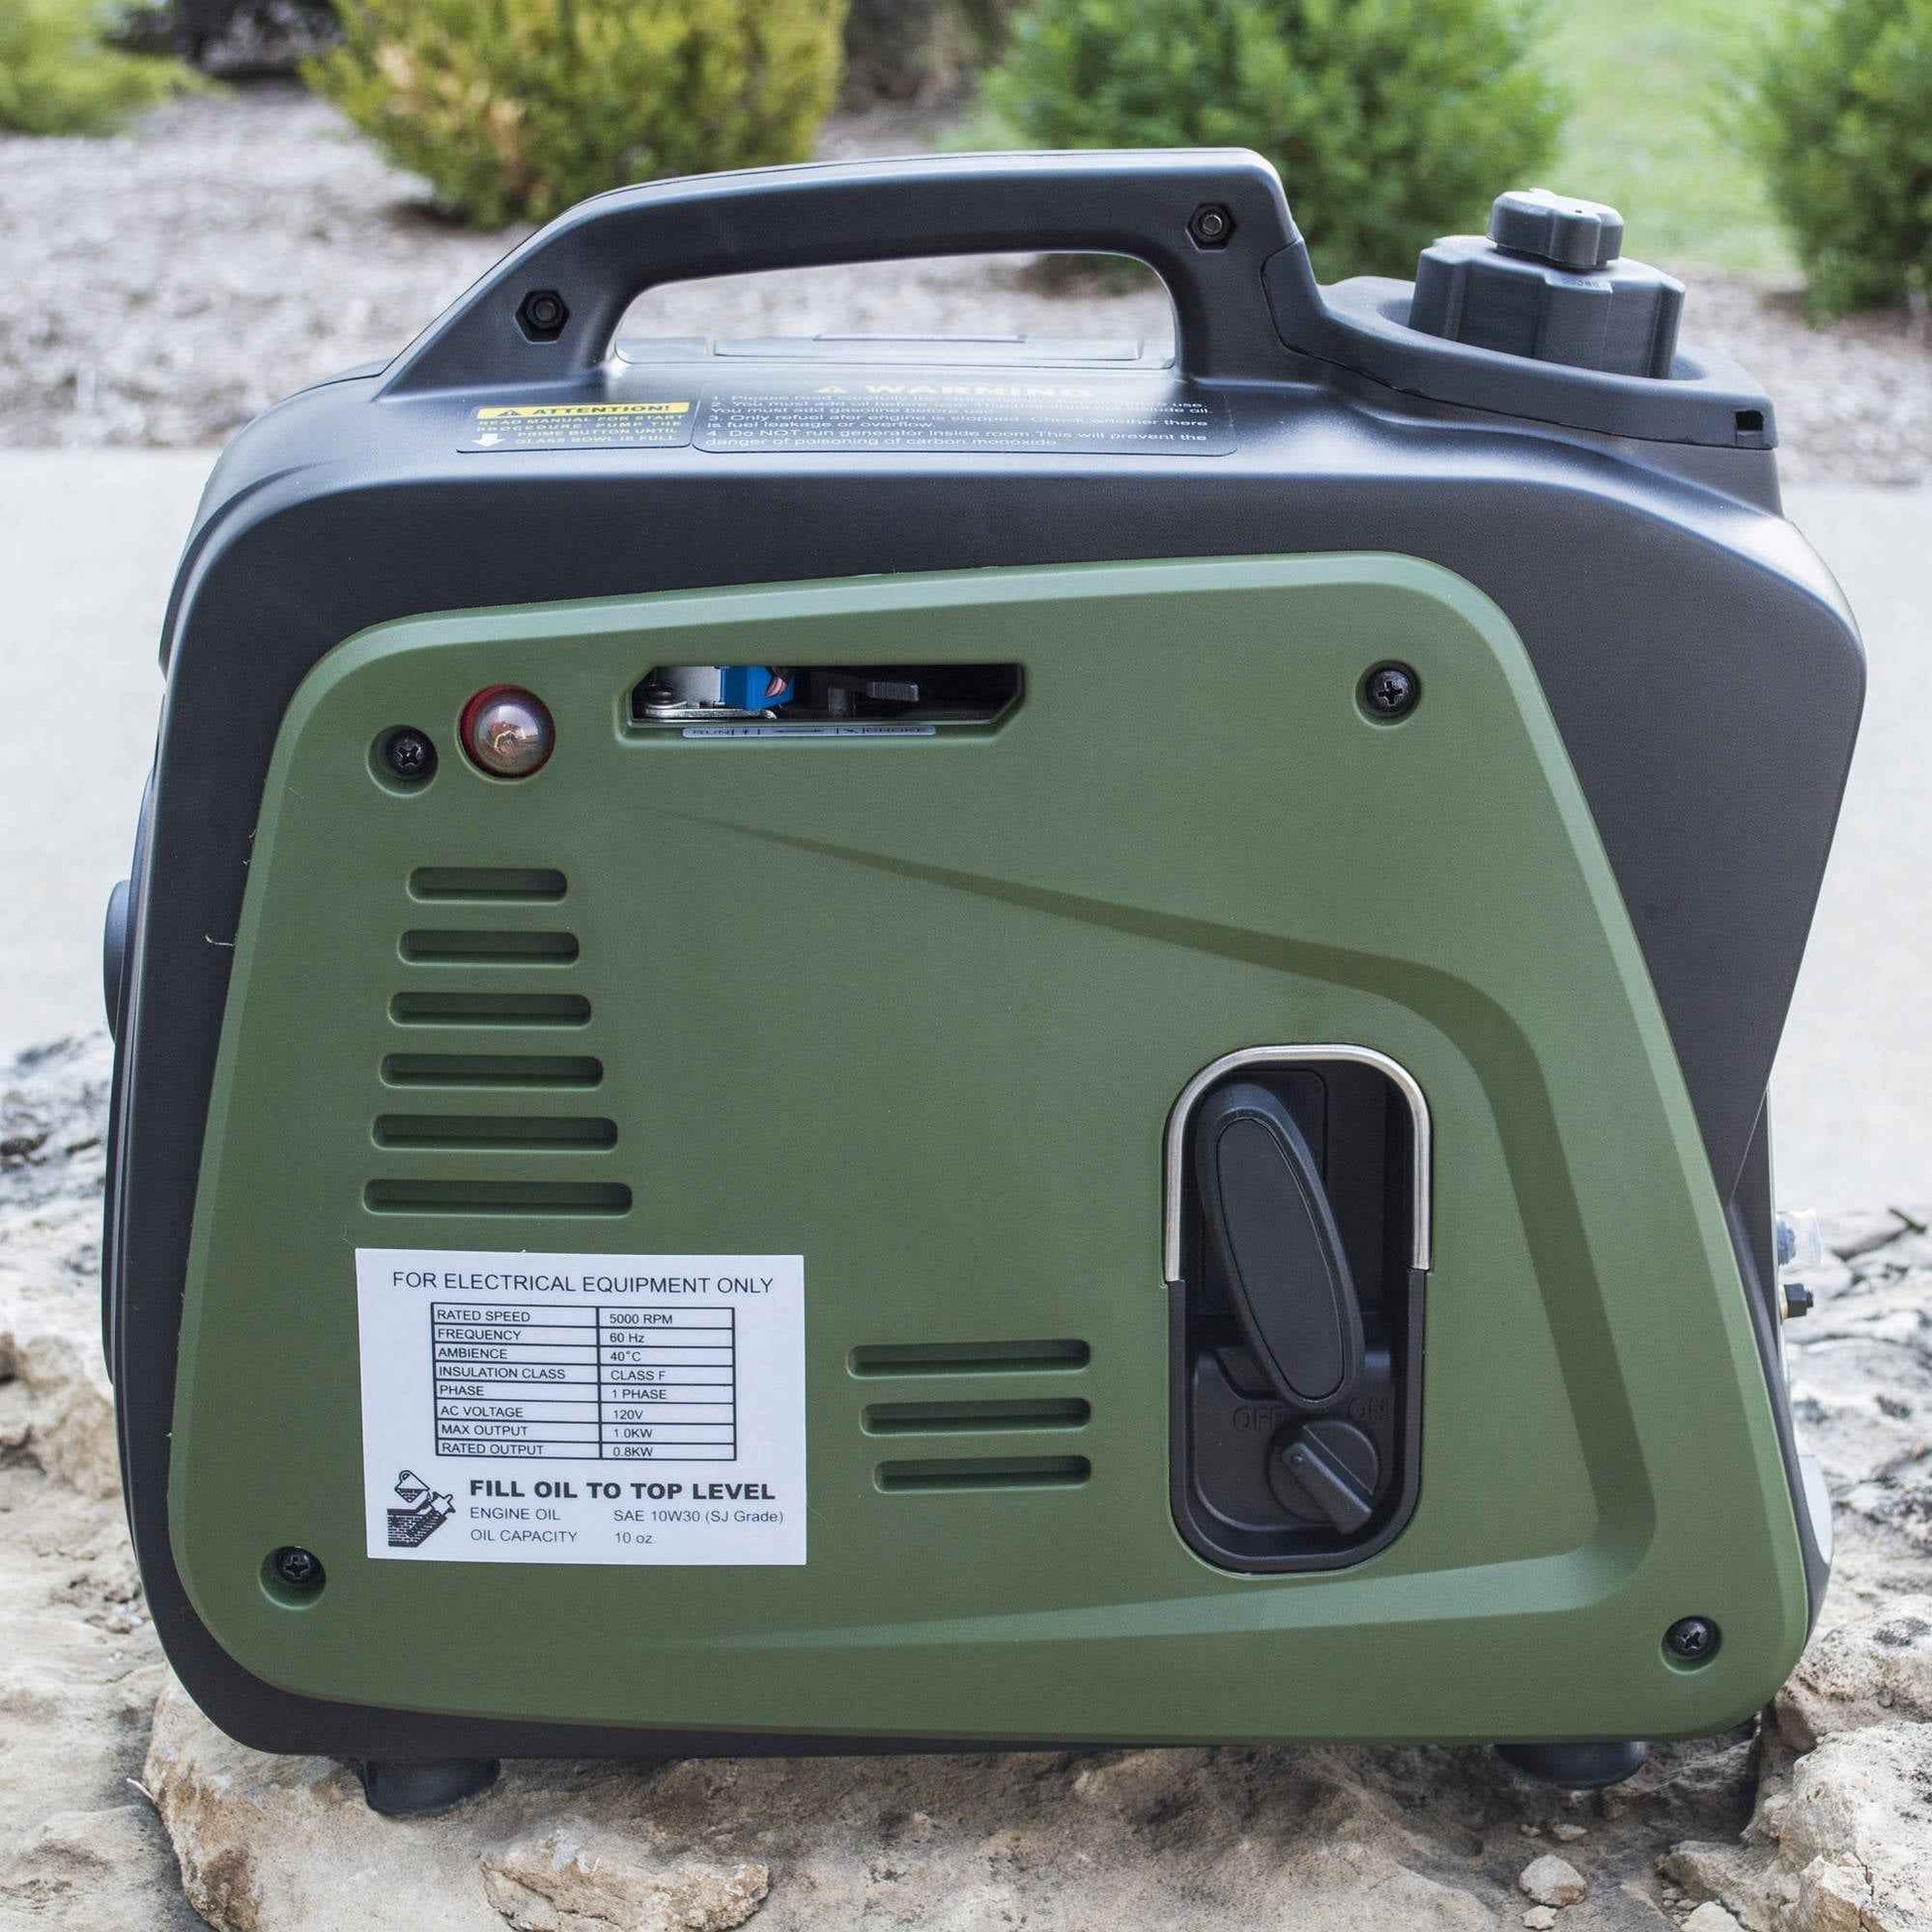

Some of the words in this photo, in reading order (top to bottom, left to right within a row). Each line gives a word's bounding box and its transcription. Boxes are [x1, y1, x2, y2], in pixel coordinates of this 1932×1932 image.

[866, 385, 1093, 397] WARNING
[533, 405, 670, 415] ATTENTION!
[526, 416, 594, 425] MANUAL
[840, 429, 923, 438] generator
[1078, 431, 1105, 440] will
[1110, 432, 1176, 441] prevent
[706, 438, 768, 447] danger
[795, 437, 880, 447] poisoning
[906, 437, 967, 446] carbon
[393, 1272, 437, 1288] FOR
[445, 1274, 576, 1292] ELECTRICAL
[583, 1277, 710, 1293] EQUIPMENT
[718, 1278, 772, 1294] ONLY
[437, 1310, 481, 1322] RATED
[485, 1311, 530, 1321] SPEED
[610, 1313, 639, 1324] 5000
[643, 1314, 672, 1323] RPM
[437, 1328, 521, 1342] FREQUENCY
[610, 1332, 624, 1342] 60
[628, 1333, 644, 1343] Hz
[438, 1347, 507, 1360] AMBIENCE
[439, 1366, 517, 1379] INSULATION
[522, 1368, 565, 1379] CLASS
[611, 1370, 654, 1381] CLASS
[659, 1371, 665, 1380] F
[440, 1385, 483, 1396] PHASE
[613, 1389, 617, 1398] 1
[622, 1389, 666, 1399] PHASE
[441, 1406, 459, 1416] AC
[463, 1407, 522, 1419] VOLTAGE
[615, 1410, 643, 1420] 120V
[442, 1425, 470, 1435] MAX
[475, 1425, 527, 1436] OUTPUT
[614, 1429, 652, 1438] 1.0KW
[442, 1443, 485, 1454] RATED
[488, 1445, 543, 1456] OUTPUT
[614, 1447, 652, 1458] 0.8KW
[471, 1480, 524, 1497] FILL
[534, 1481, 578, 1498] OIL
[587, 1482, 621, 1499] TO
[630, 1483, 682, 1499] TOP
[693, 1483, 775, 1499] LEVEL
[471, 1507, 529, 1521] ENGINE
[536, 1509, 560, 1520] OIL
[614, 1510, 644, 1521] SAE
[652, 1510, 700, 1522] 10W30
[705, 1510, 728, 1525] (SJ
[734, 1510, 783, 1525] Grade)
[471, 1529, 495, 1541] OIL
[500, 1530, 577, 1542] CAPACITY
[616, 1532, 631, 1544] 10
